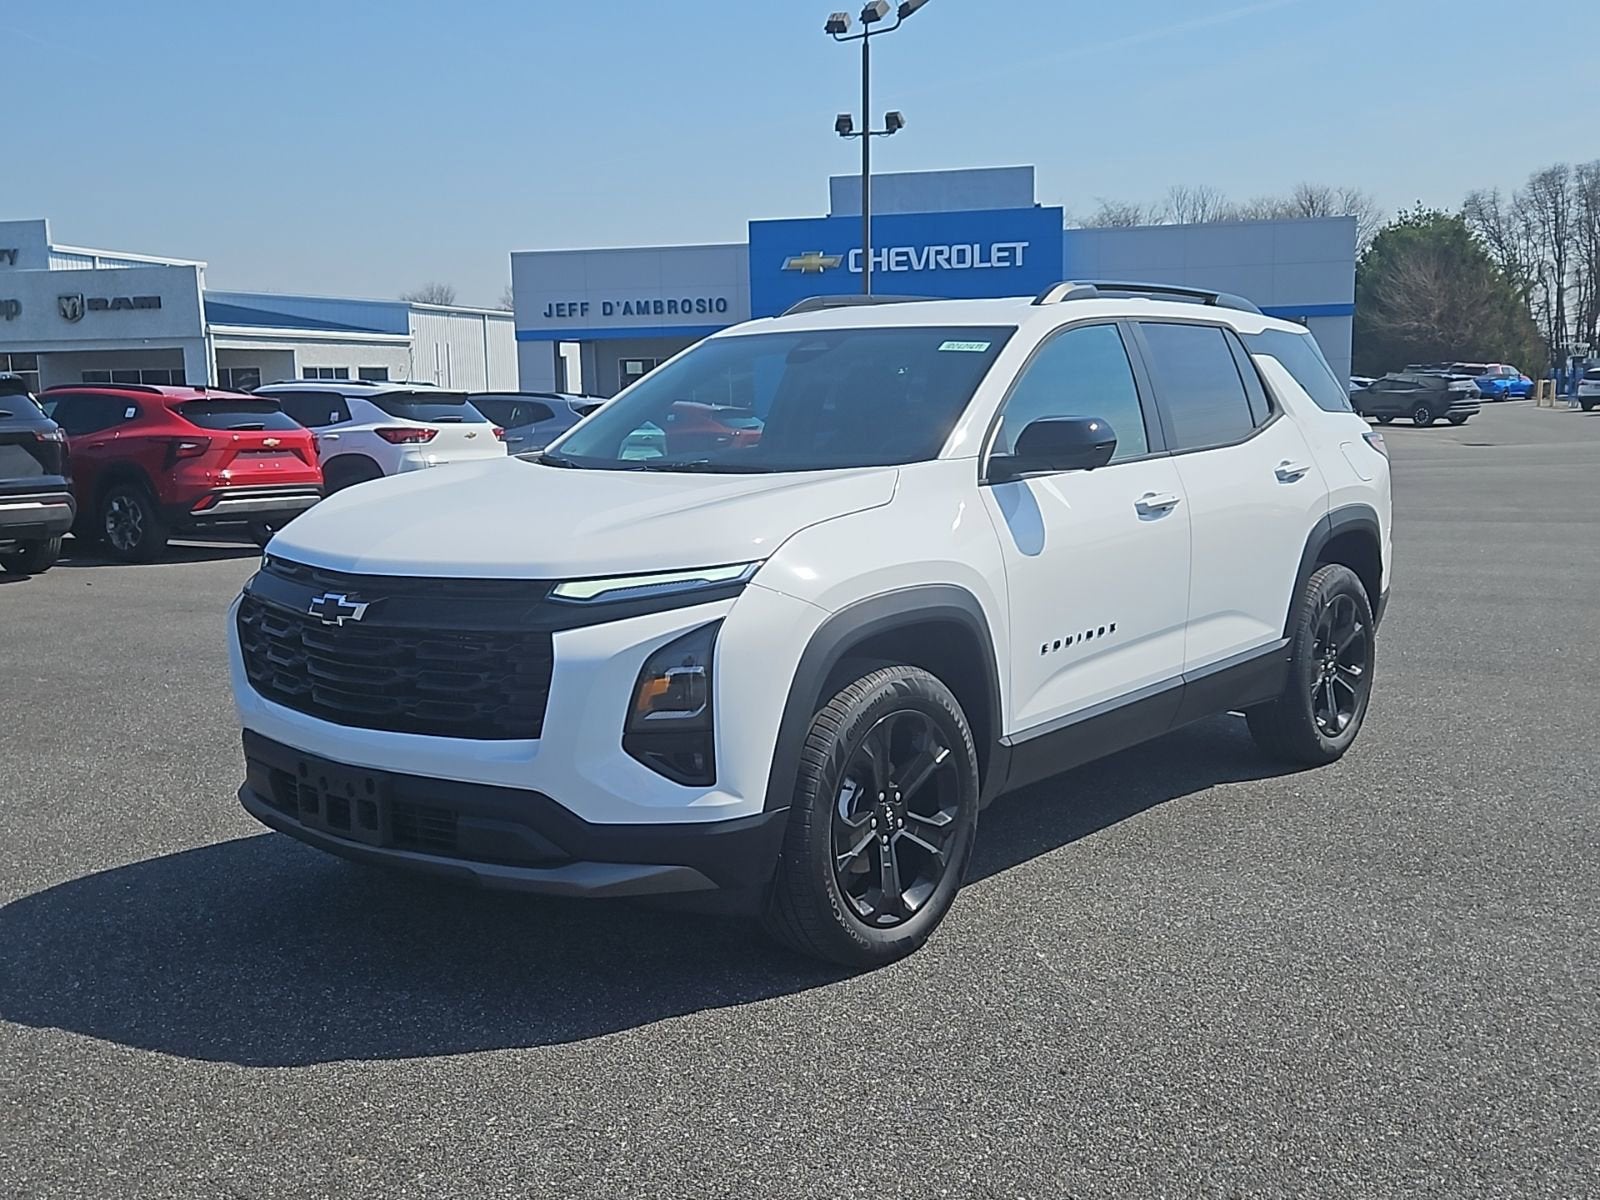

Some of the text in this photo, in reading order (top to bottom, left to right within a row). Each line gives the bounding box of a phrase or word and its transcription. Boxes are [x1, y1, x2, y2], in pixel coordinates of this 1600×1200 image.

[848, 241, 1029, 273] CHEVROLET
[87, 295, 162, 311] RAM
[543, 297, 727, 318] JEFF D'AMBROSIO
[1040, 622, 1117, 656] EQUINOX
